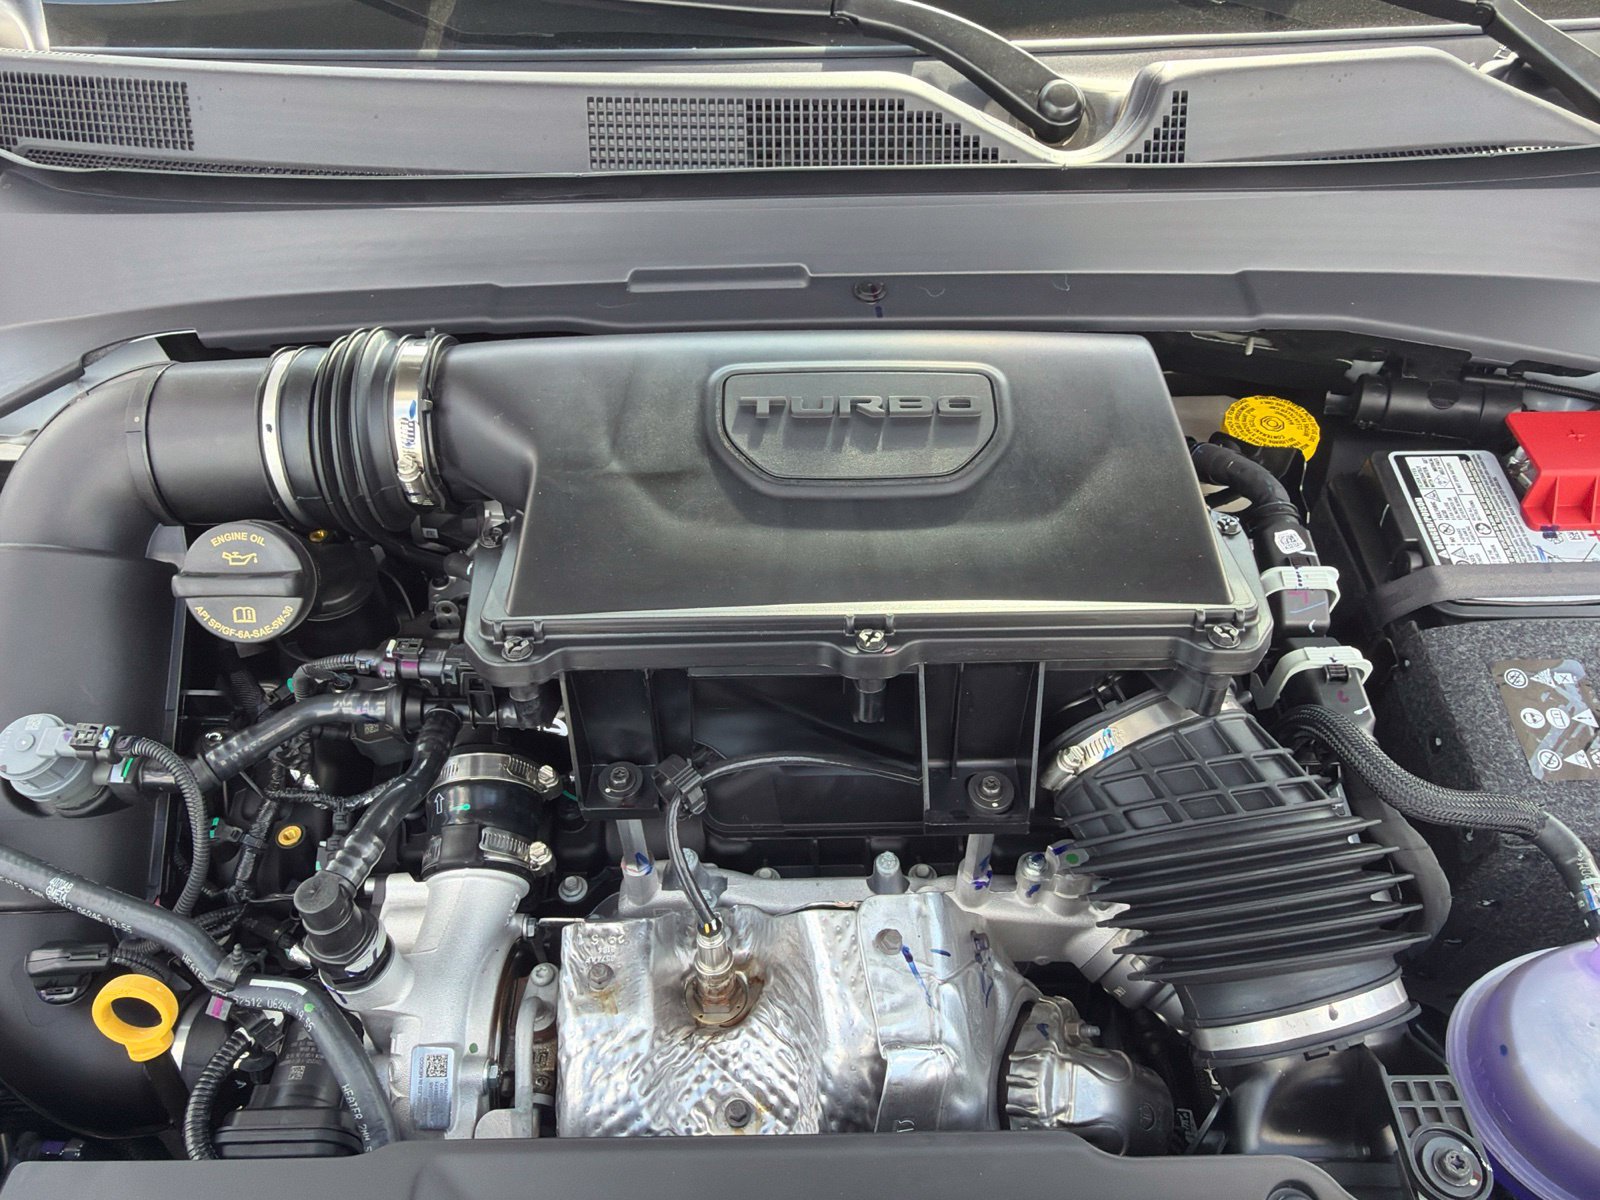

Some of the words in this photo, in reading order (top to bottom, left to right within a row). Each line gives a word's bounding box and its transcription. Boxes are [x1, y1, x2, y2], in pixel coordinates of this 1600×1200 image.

[739, 396, 983, 418] TURBO
[1414, 497, 1446, 550] DANGER/POISON
[210, 532, 247, 547] ENGINE
[250, 533, 266, 547] OIL
[195, 606, 210, 622] API
[341, 1083, 363, 1120] HEATER
